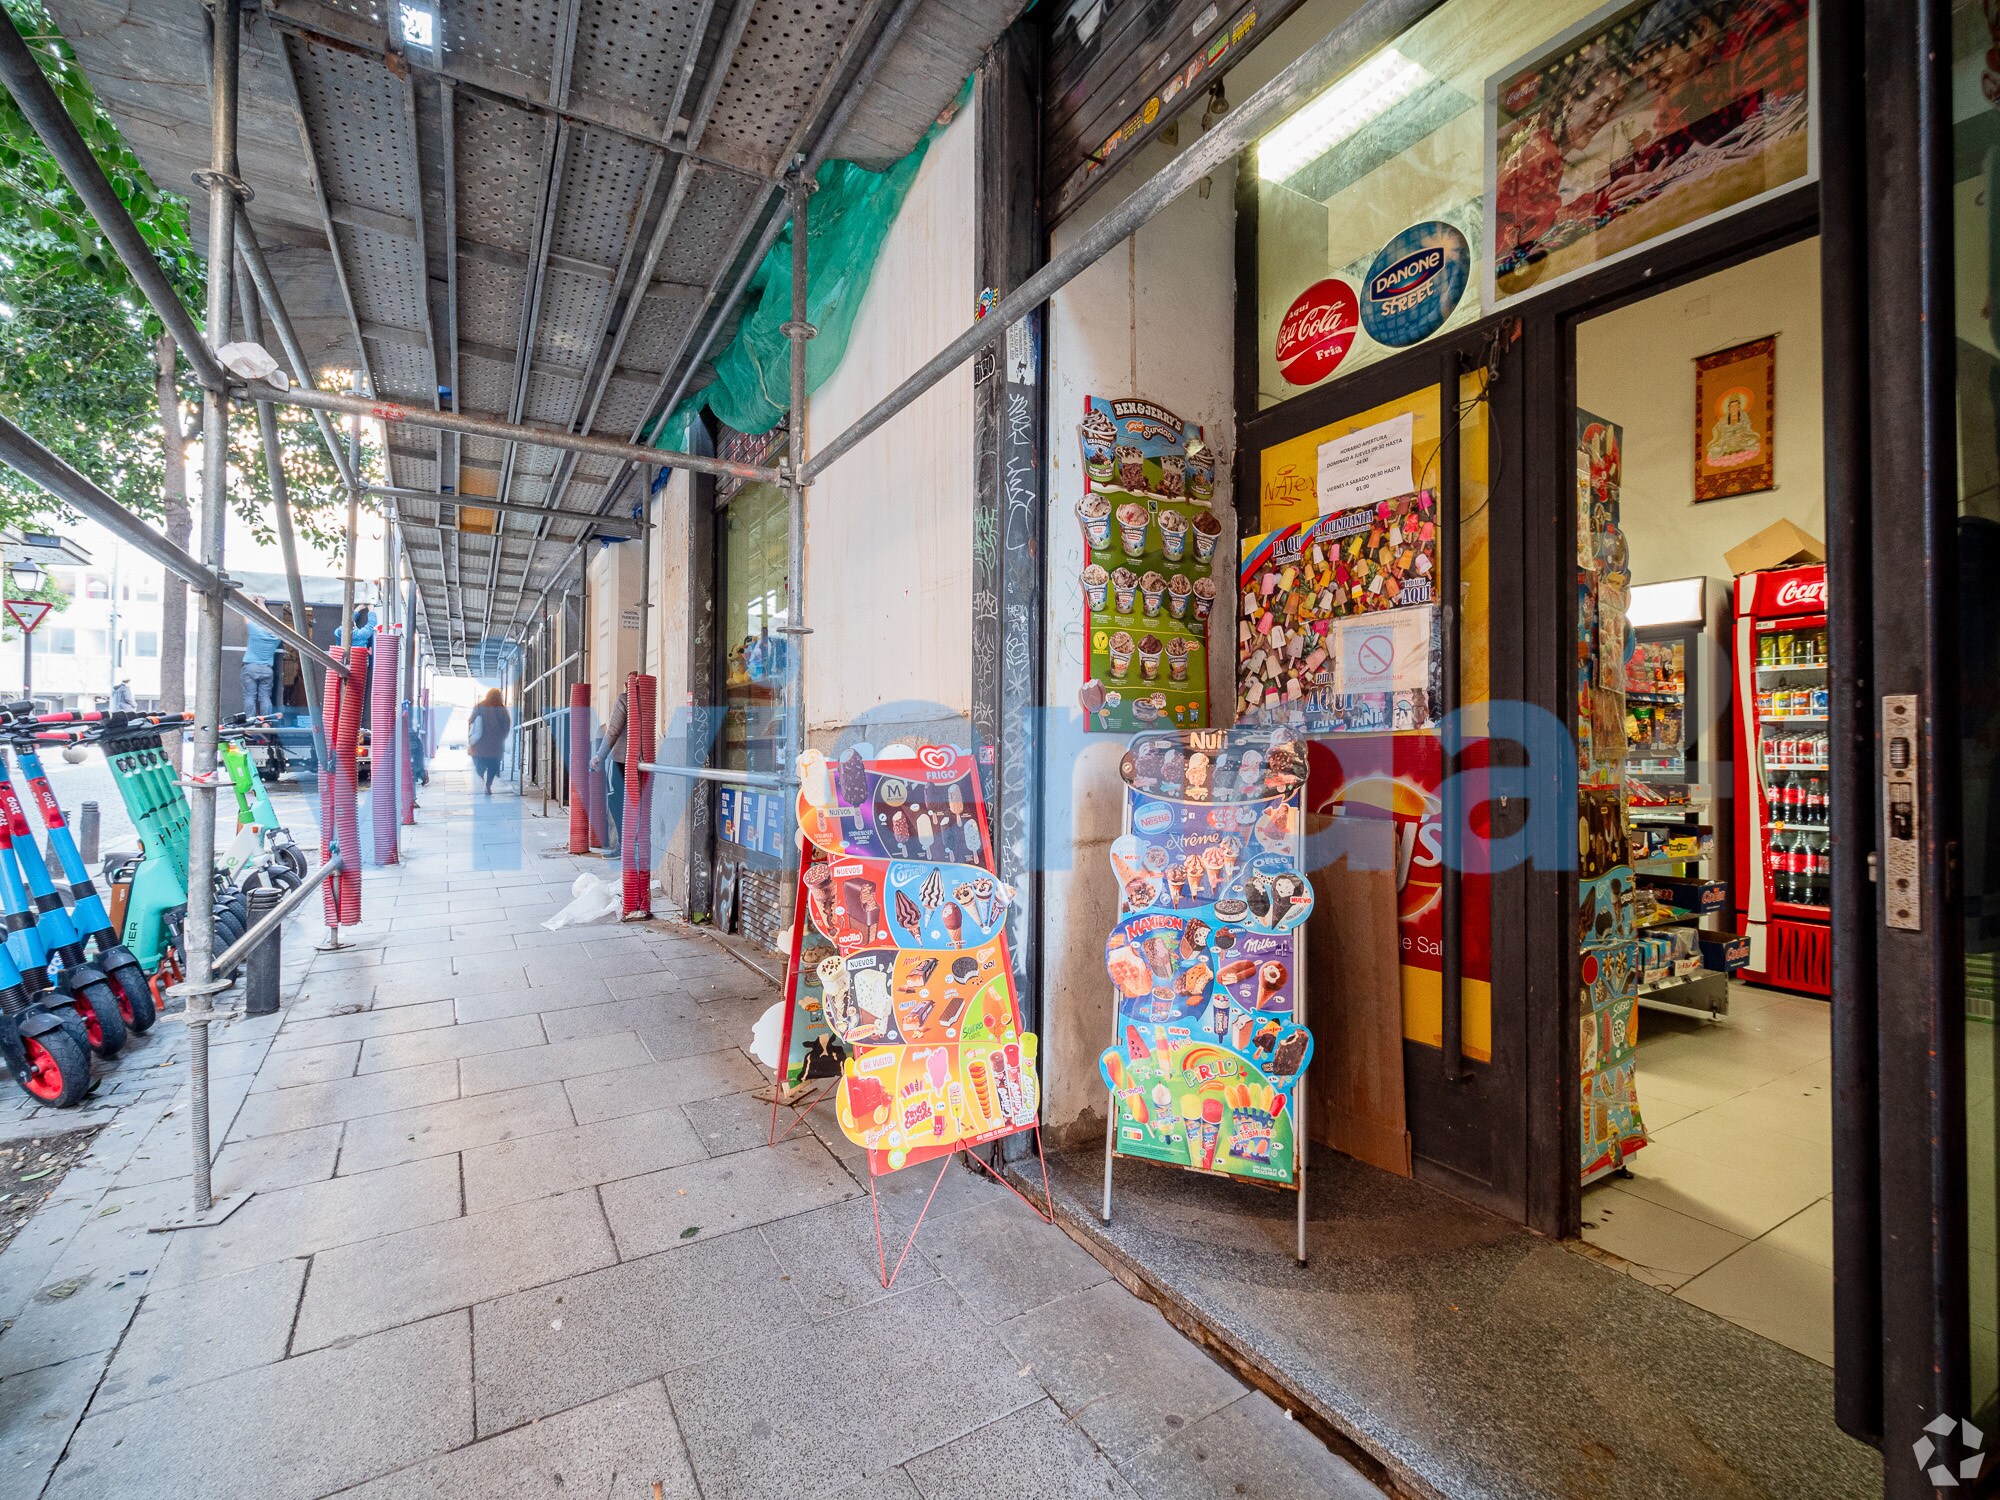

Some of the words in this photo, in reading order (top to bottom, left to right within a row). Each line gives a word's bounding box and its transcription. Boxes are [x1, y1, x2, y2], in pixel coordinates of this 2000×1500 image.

[1340, 443, 1361, 455] HORARIO
[1361, 434, 1388, 447] APERTURA
[1326, 456, 1349, 468] DOMINGO
[1354, 449, 1371, 460] JUEVES
[1385, 438, 1403, 448] HASTA
[1356, 457, 1369, 466] 24:00
[1326, 483, 1345, 493] VIERNES
[1349, 475, 1369, 486] SABADO
[1384, 465, 1401, 475] HASTA
[1313, 523, 1323, 537] LA
[1272, 540, 1286, 557] LA
[925, 770, 956, 780] FRIGO
[6, 796, 22, 815] dott
[42, 791, 57, 809] dott
[829, 808, 851, 816] NUEVOS
[1252, 857, 1288, 868] OREO
[127, 922, 138, 949] TIER
[1126, 915, 1183, 941] MAXIBON
[1244, 938, 1278, 953] Milka
[850, 958, 874, 968] NUEVOS
[1169, 1027, 1190, 1035] NUEVO
